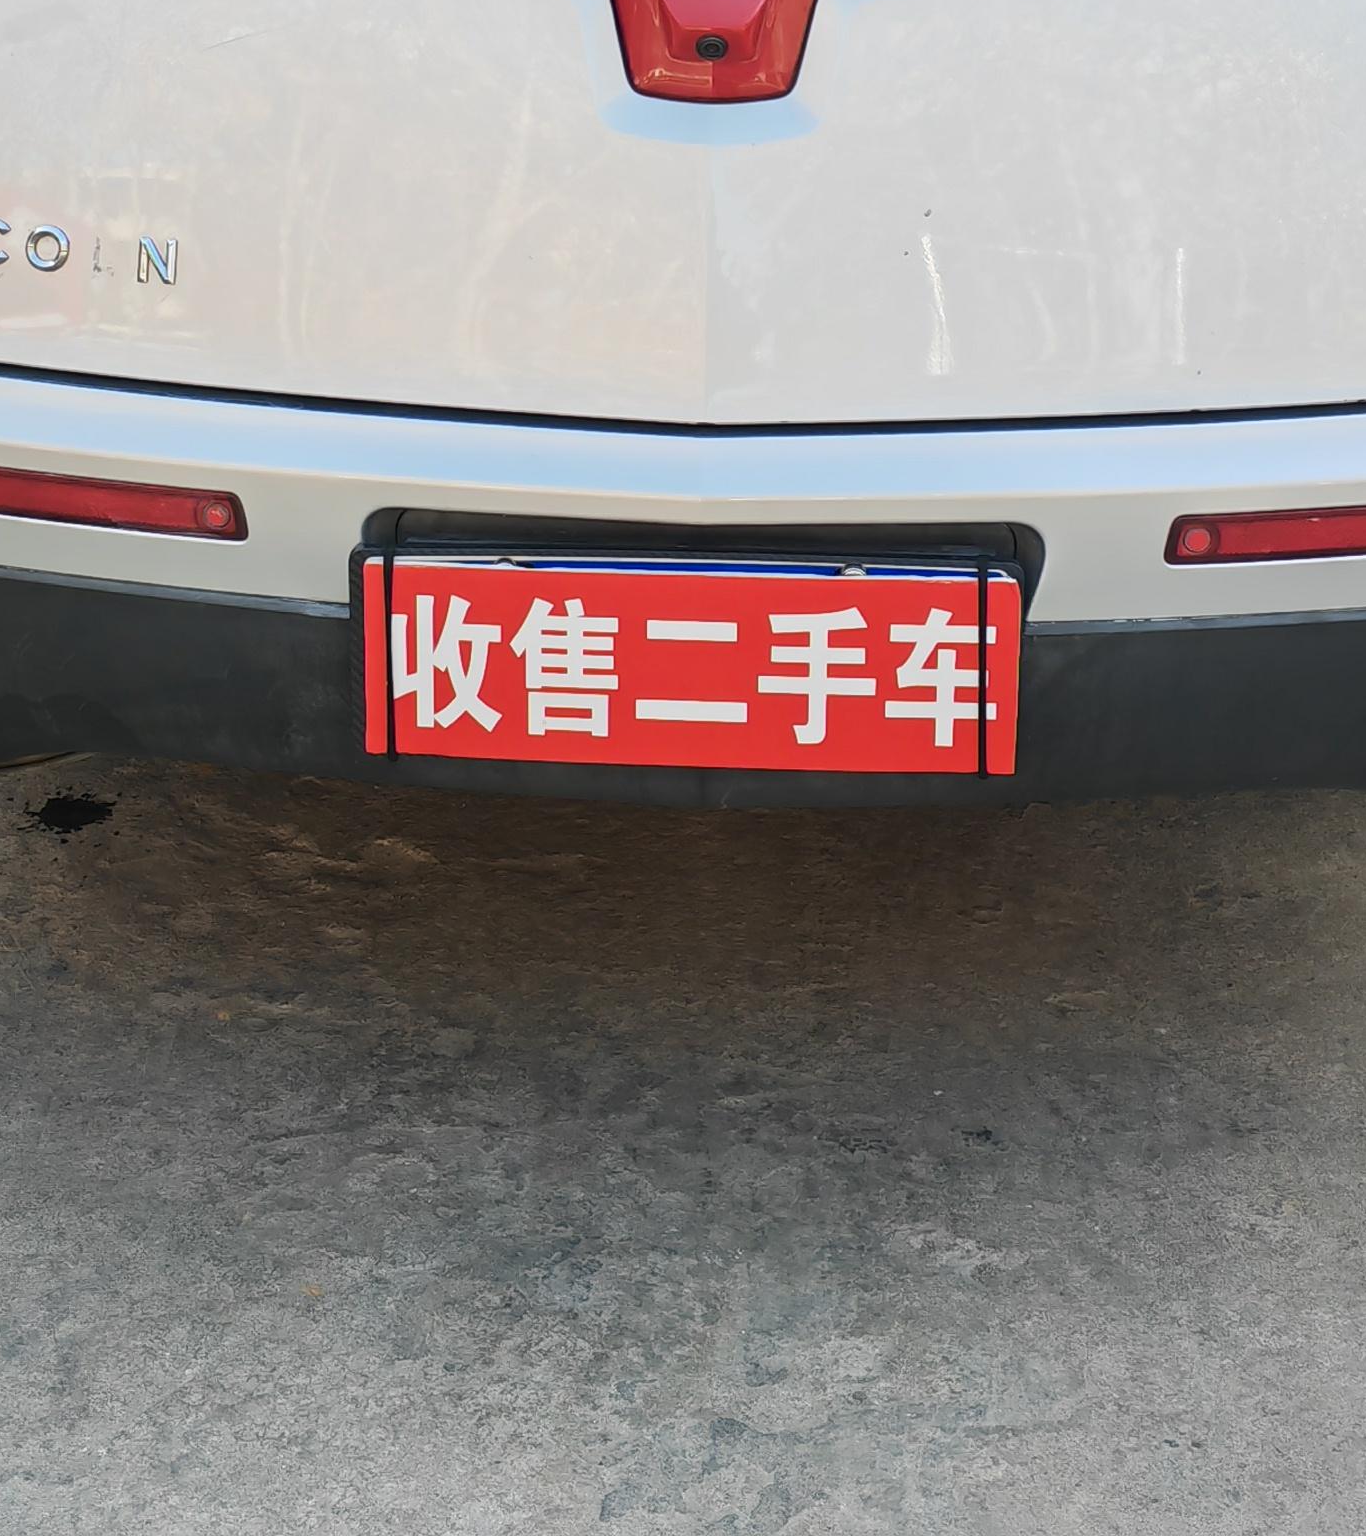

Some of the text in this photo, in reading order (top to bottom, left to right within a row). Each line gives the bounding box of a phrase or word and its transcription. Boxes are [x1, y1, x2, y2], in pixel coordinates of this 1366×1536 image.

[391, 595, 997, 748] 收售二手车
